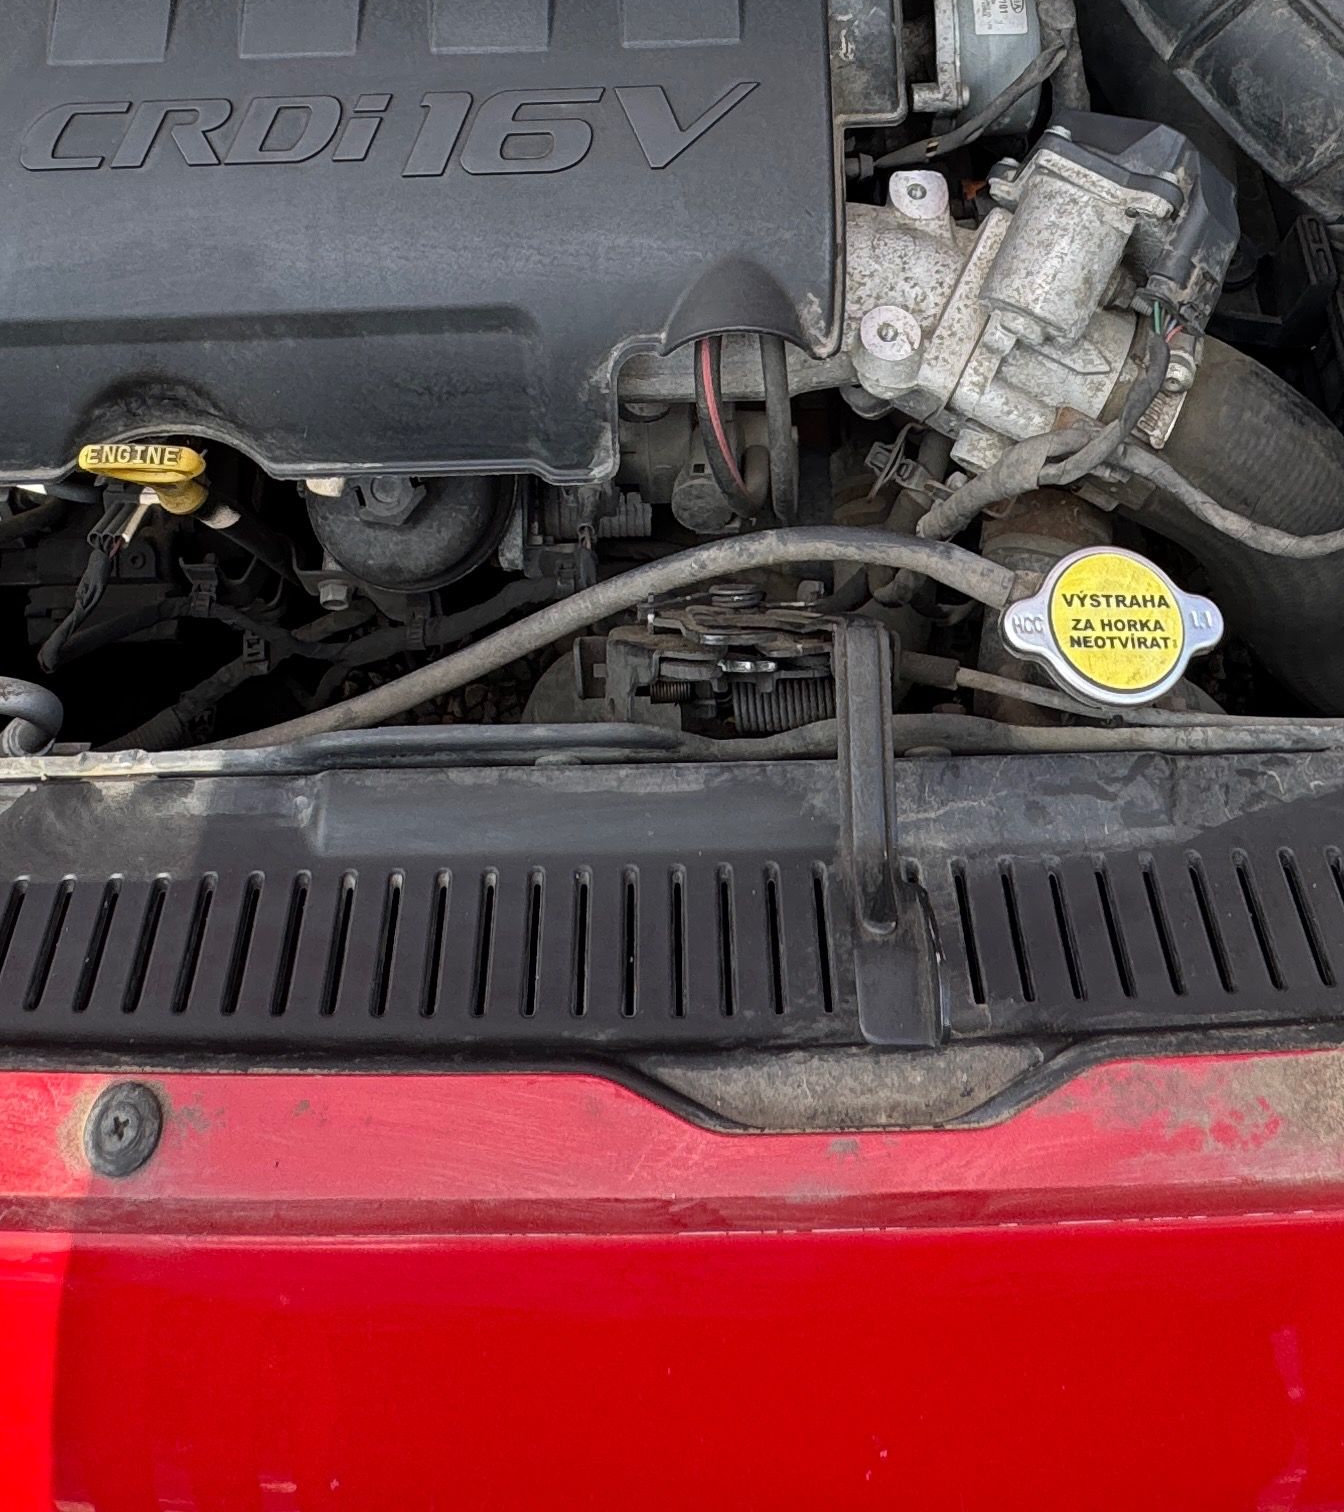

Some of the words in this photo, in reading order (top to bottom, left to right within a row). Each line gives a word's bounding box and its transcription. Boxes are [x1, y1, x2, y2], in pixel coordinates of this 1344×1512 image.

[19, 92, 394, 172] CRDi
[401, 81, 762, 177] 16V
[86, 445, 181, 466] ENGINE
[1061, 590, 1171, 609] VÝSTRAHA
[1071, 619, 1096, 632] ZA
[1101, 619, 1166, 632] HORKA
[1069, 633, 1171, 650] NEOTVÍRAT
